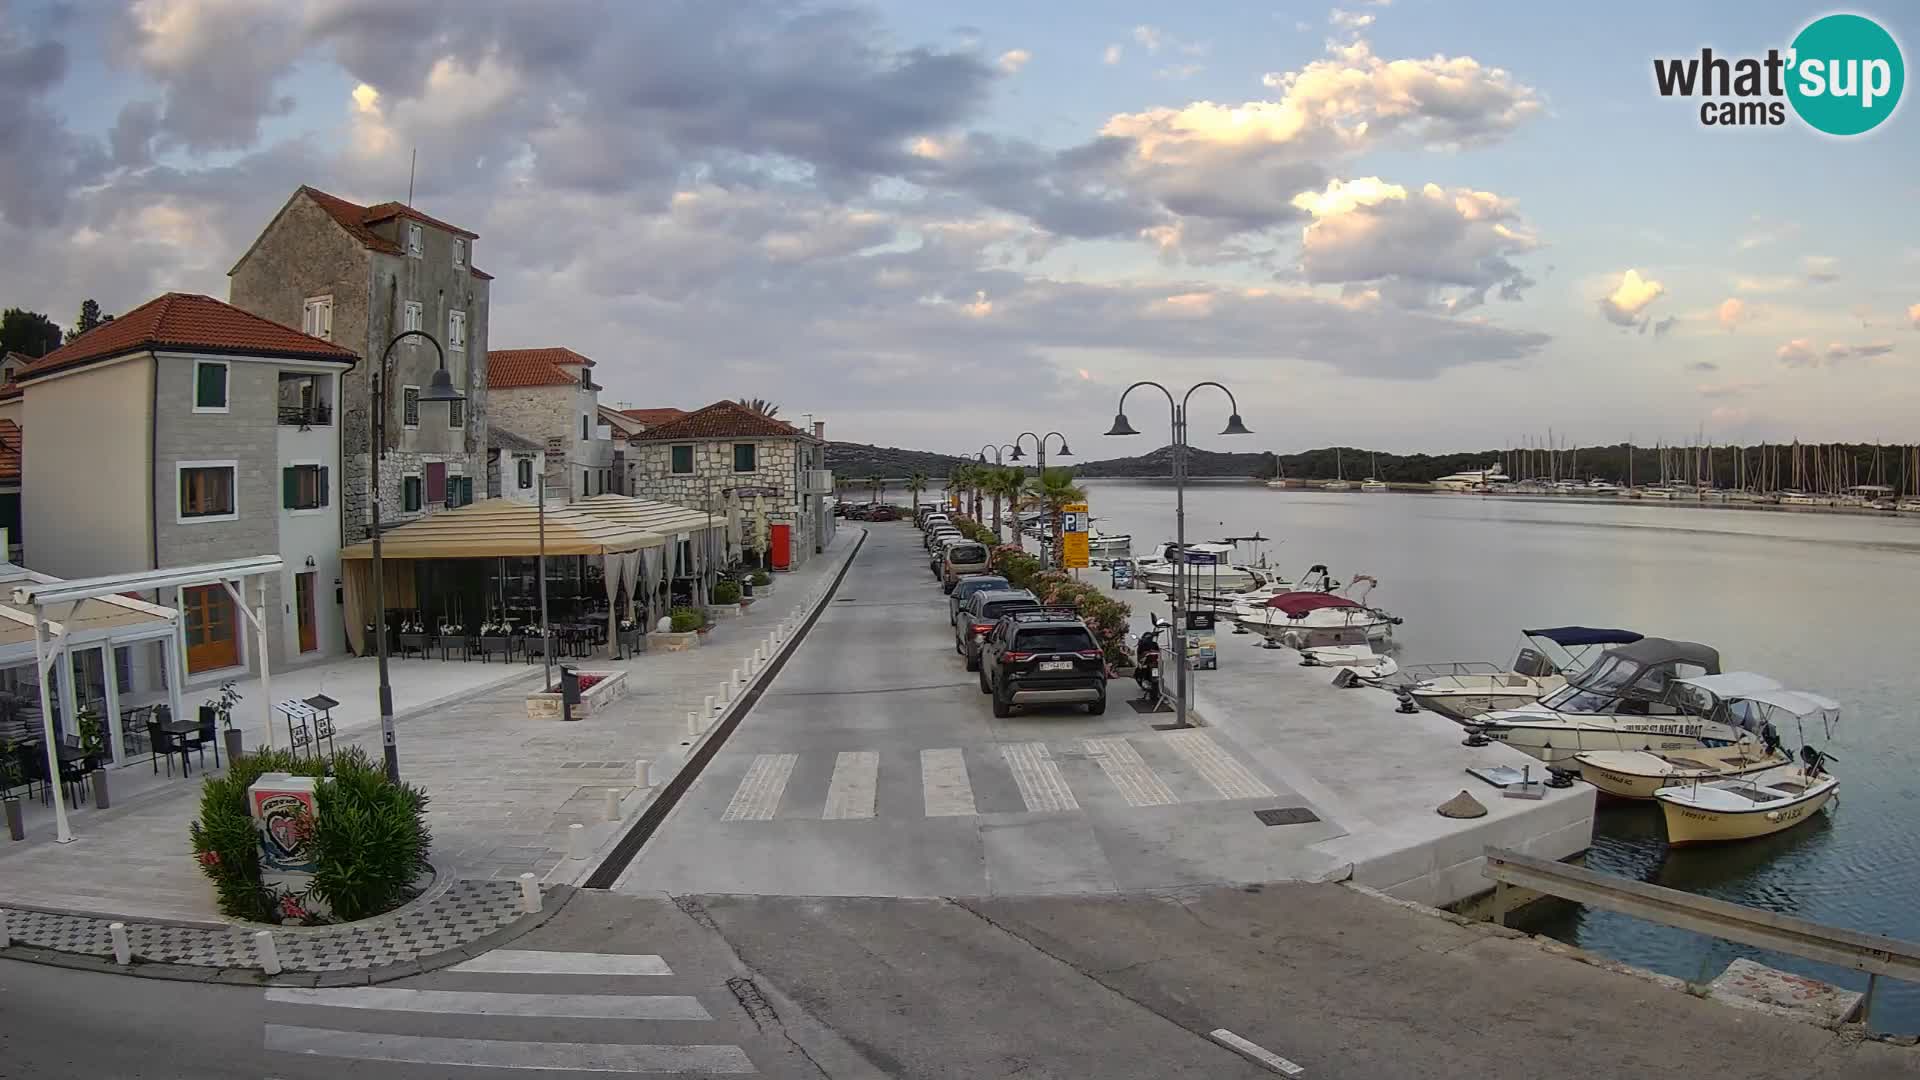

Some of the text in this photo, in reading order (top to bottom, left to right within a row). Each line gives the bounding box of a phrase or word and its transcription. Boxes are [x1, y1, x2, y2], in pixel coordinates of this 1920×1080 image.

[1065, 514, 1076, 530] P
[1659, 724, 1678, 734] RENT
[1678, 724, 1684, 735] A
[1684, 724, 1703, 736] BOAT
